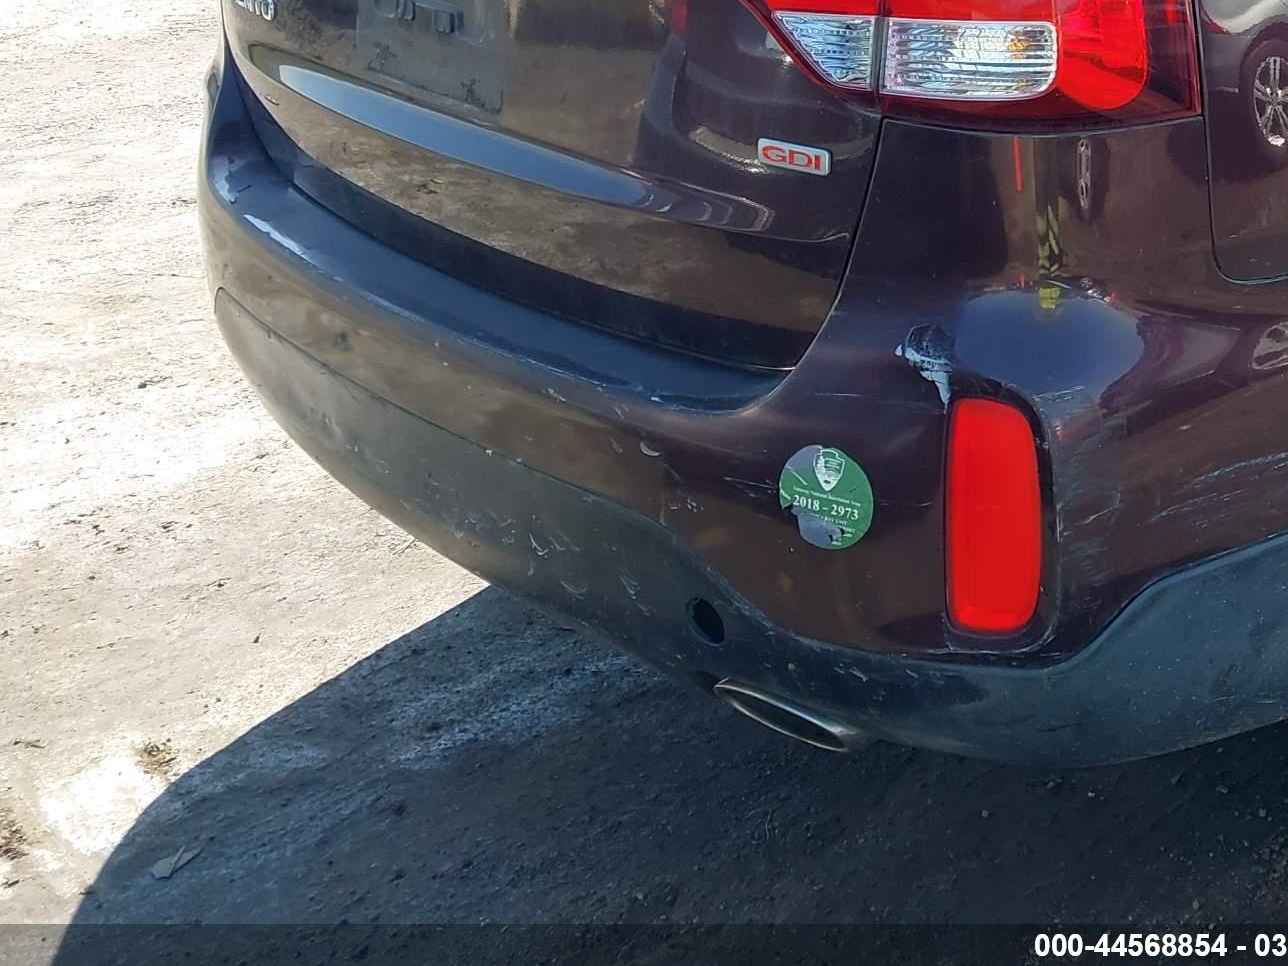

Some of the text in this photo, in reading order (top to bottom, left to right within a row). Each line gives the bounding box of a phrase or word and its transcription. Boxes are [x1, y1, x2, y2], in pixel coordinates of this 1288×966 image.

[762, 145, 822, 171] GDI
[792, 494, 820, 512] 2018
[830, 503, 859, 521] 2973
